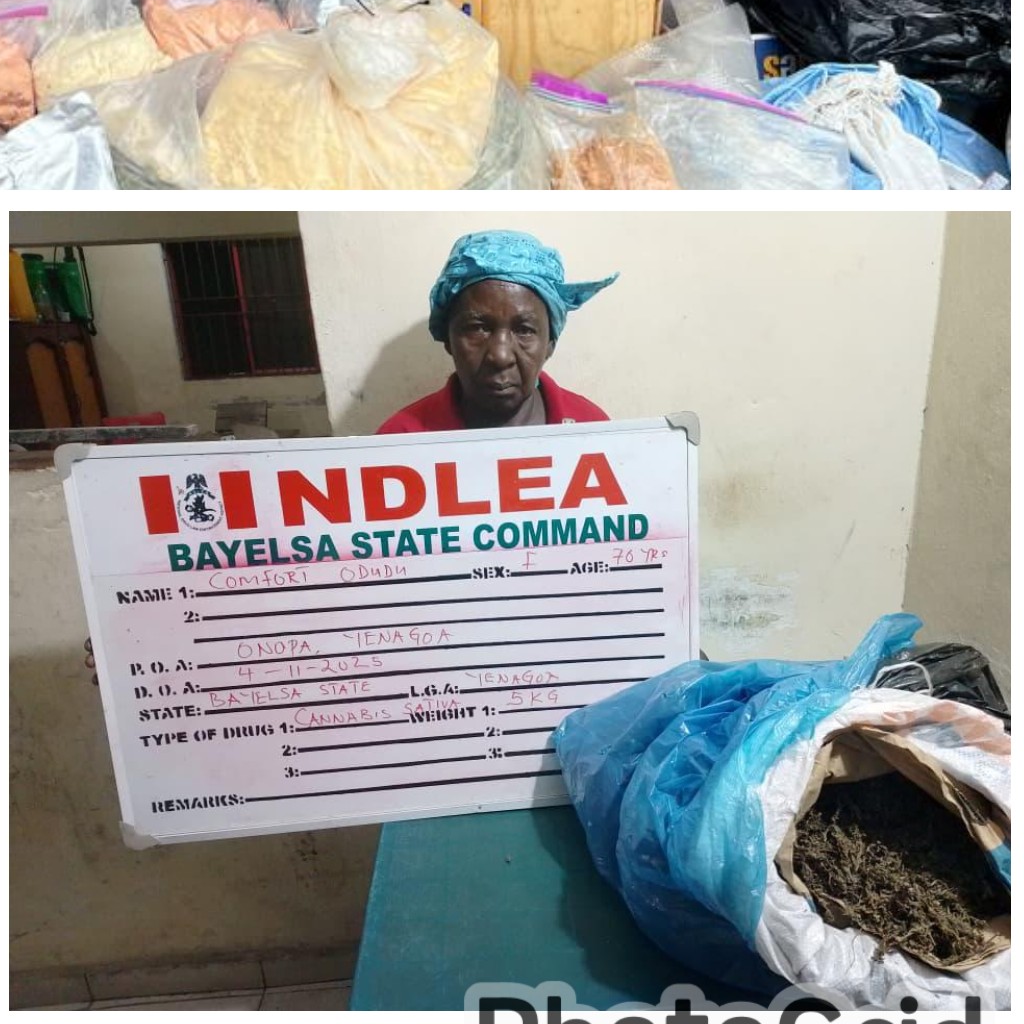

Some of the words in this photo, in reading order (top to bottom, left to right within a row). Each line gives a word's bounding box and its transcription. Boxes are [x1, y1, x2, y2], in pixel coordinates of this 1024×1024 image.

[277, 452, 629, 527] NDLEA
[167, 534, 340, 571] BAYELSA
[352, 525, 461, 560] STATE
[473, 513, 649, 551] COMMAND
[472, 566, 511, 580] SEX:
[570, 561, 609, 574] AGE:
[209, 566, 309, 589] COMFORT
[340, 564, 407, 584] ODUDU
[116, 587, 173, 604] NAME
[183, 611, 200, 623] 2:
[343, 627, 454, 648] YENAGOA
[464, 670, 560, 687] YENAGOA
[208, 688, 302, 708] BAYELSA
[319, 681, 372, 696] STATE
[410, 683, 459, 697] L.G.A:
[139, 705, 201, 722] STATE:
[294, 708, 392, 727] CANNABIS
[402, 698, 461, 714] SATIVA
[409, 706, 476, 723] WEIGHT
[139, 731, 188, 747] TYPE
[194, 730, 217, 742] OF
[223, 725, 274, 739] DRUG
[485, 727, 501, 737] 2:
[282, 744, 297, 757] 2:
[284, 767, 299, 778] 3:
[151, 794, 244, 814] REMARKS:
